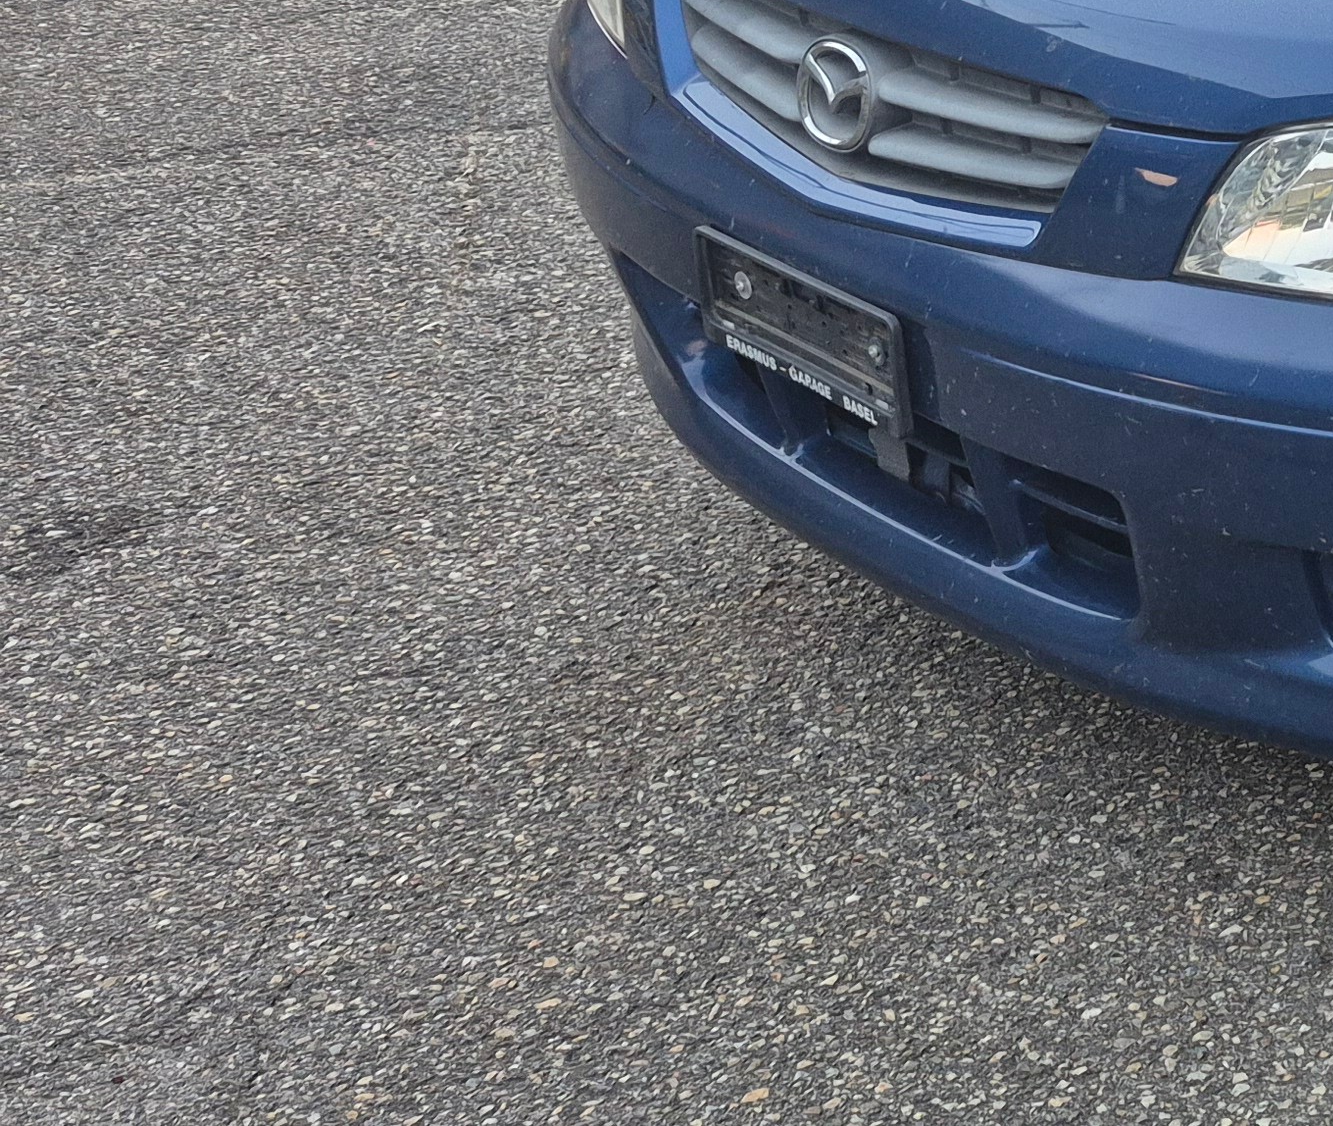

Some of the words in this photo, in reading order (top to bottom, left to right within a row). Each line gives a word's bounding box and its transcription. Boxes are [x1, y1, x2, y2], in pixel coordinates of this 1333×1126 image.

[725, 334, 777, 371] ERASMUS
[788, 364, 832, 401] GARAGE
[842, 395, 878, 426] BASEL
